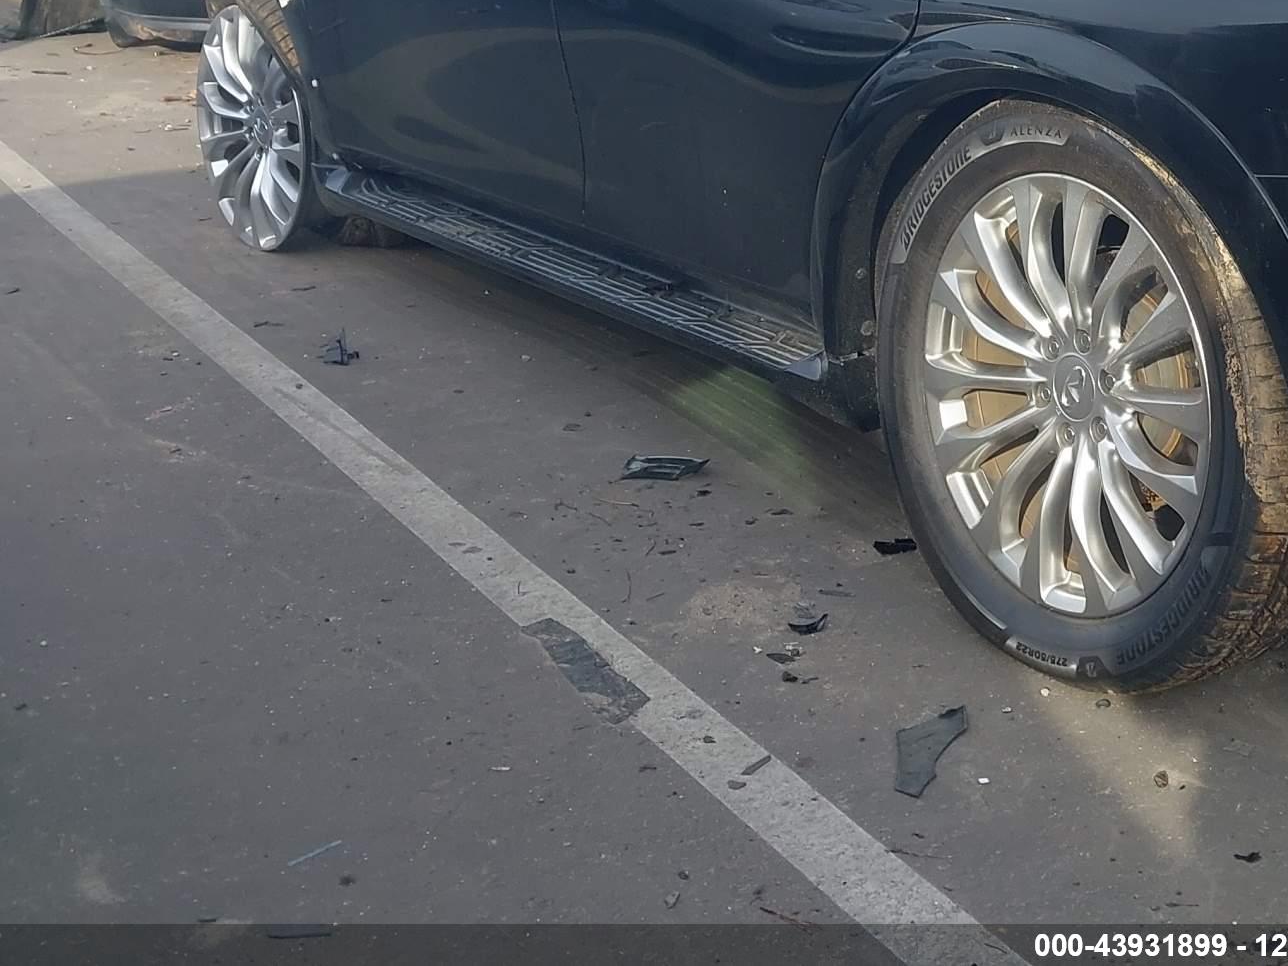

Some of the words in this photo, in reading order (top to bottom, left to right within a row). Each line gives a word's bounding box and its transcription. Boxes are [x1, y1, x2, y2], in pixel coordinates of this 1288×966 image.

[1010, 124, 1062, 139] ALENZA
[900, 145, 972, 252] BRIDGESTONE
[1115, 566, 1210, 666] BRIDGESTONE
[1015, 641, 1068, 667] 275/50R22
